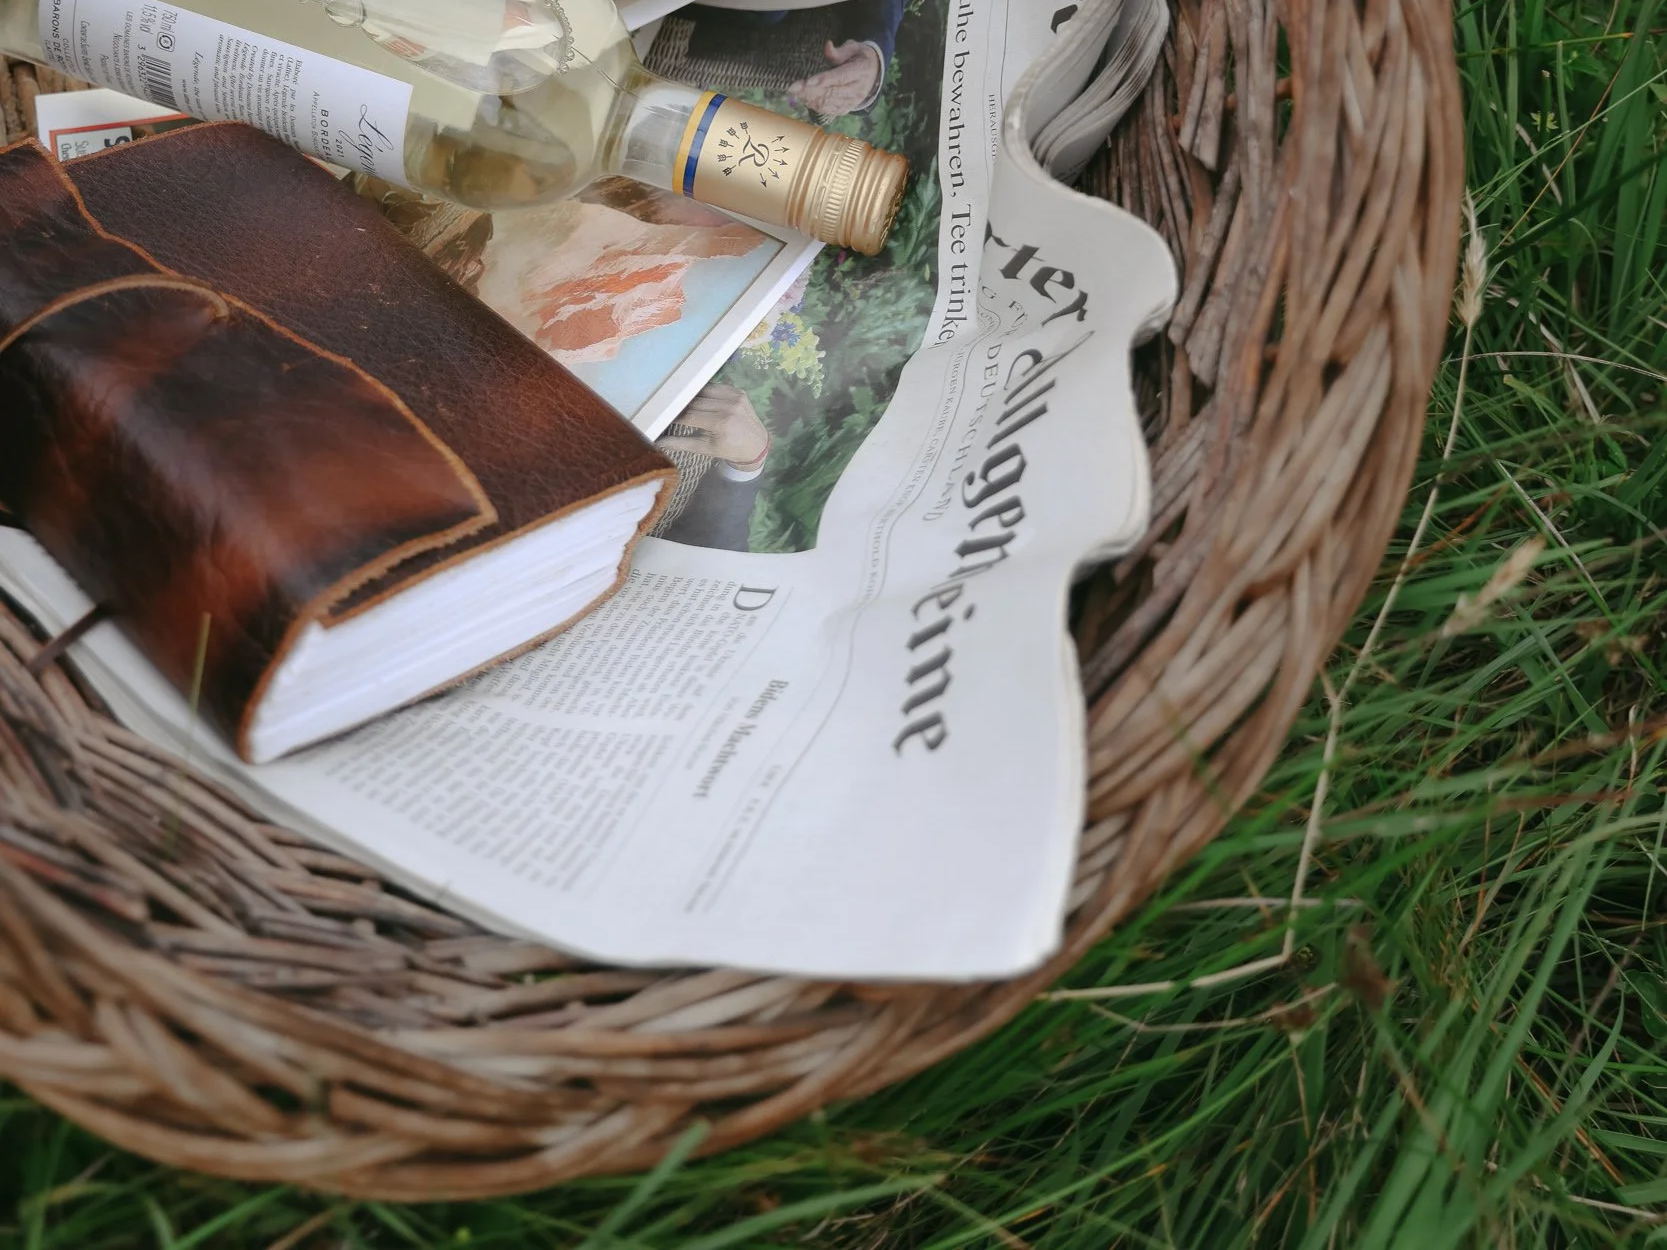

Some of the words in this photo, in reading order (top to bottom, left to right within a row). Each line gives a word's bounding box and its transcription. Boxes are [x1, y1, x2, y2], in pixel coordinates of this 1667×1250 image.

[335, 139, 345, 158] 2021
[948, 50, 970, 198] bewahren,
[950, 203, 971, 254] Tee
[921, 341, 1003, 523] DEUTSCHLAND
[733, 584, 777, 611] D
[744, 679, 789, 719] Bidens
[692, 724, 758, 798] Machtwort
